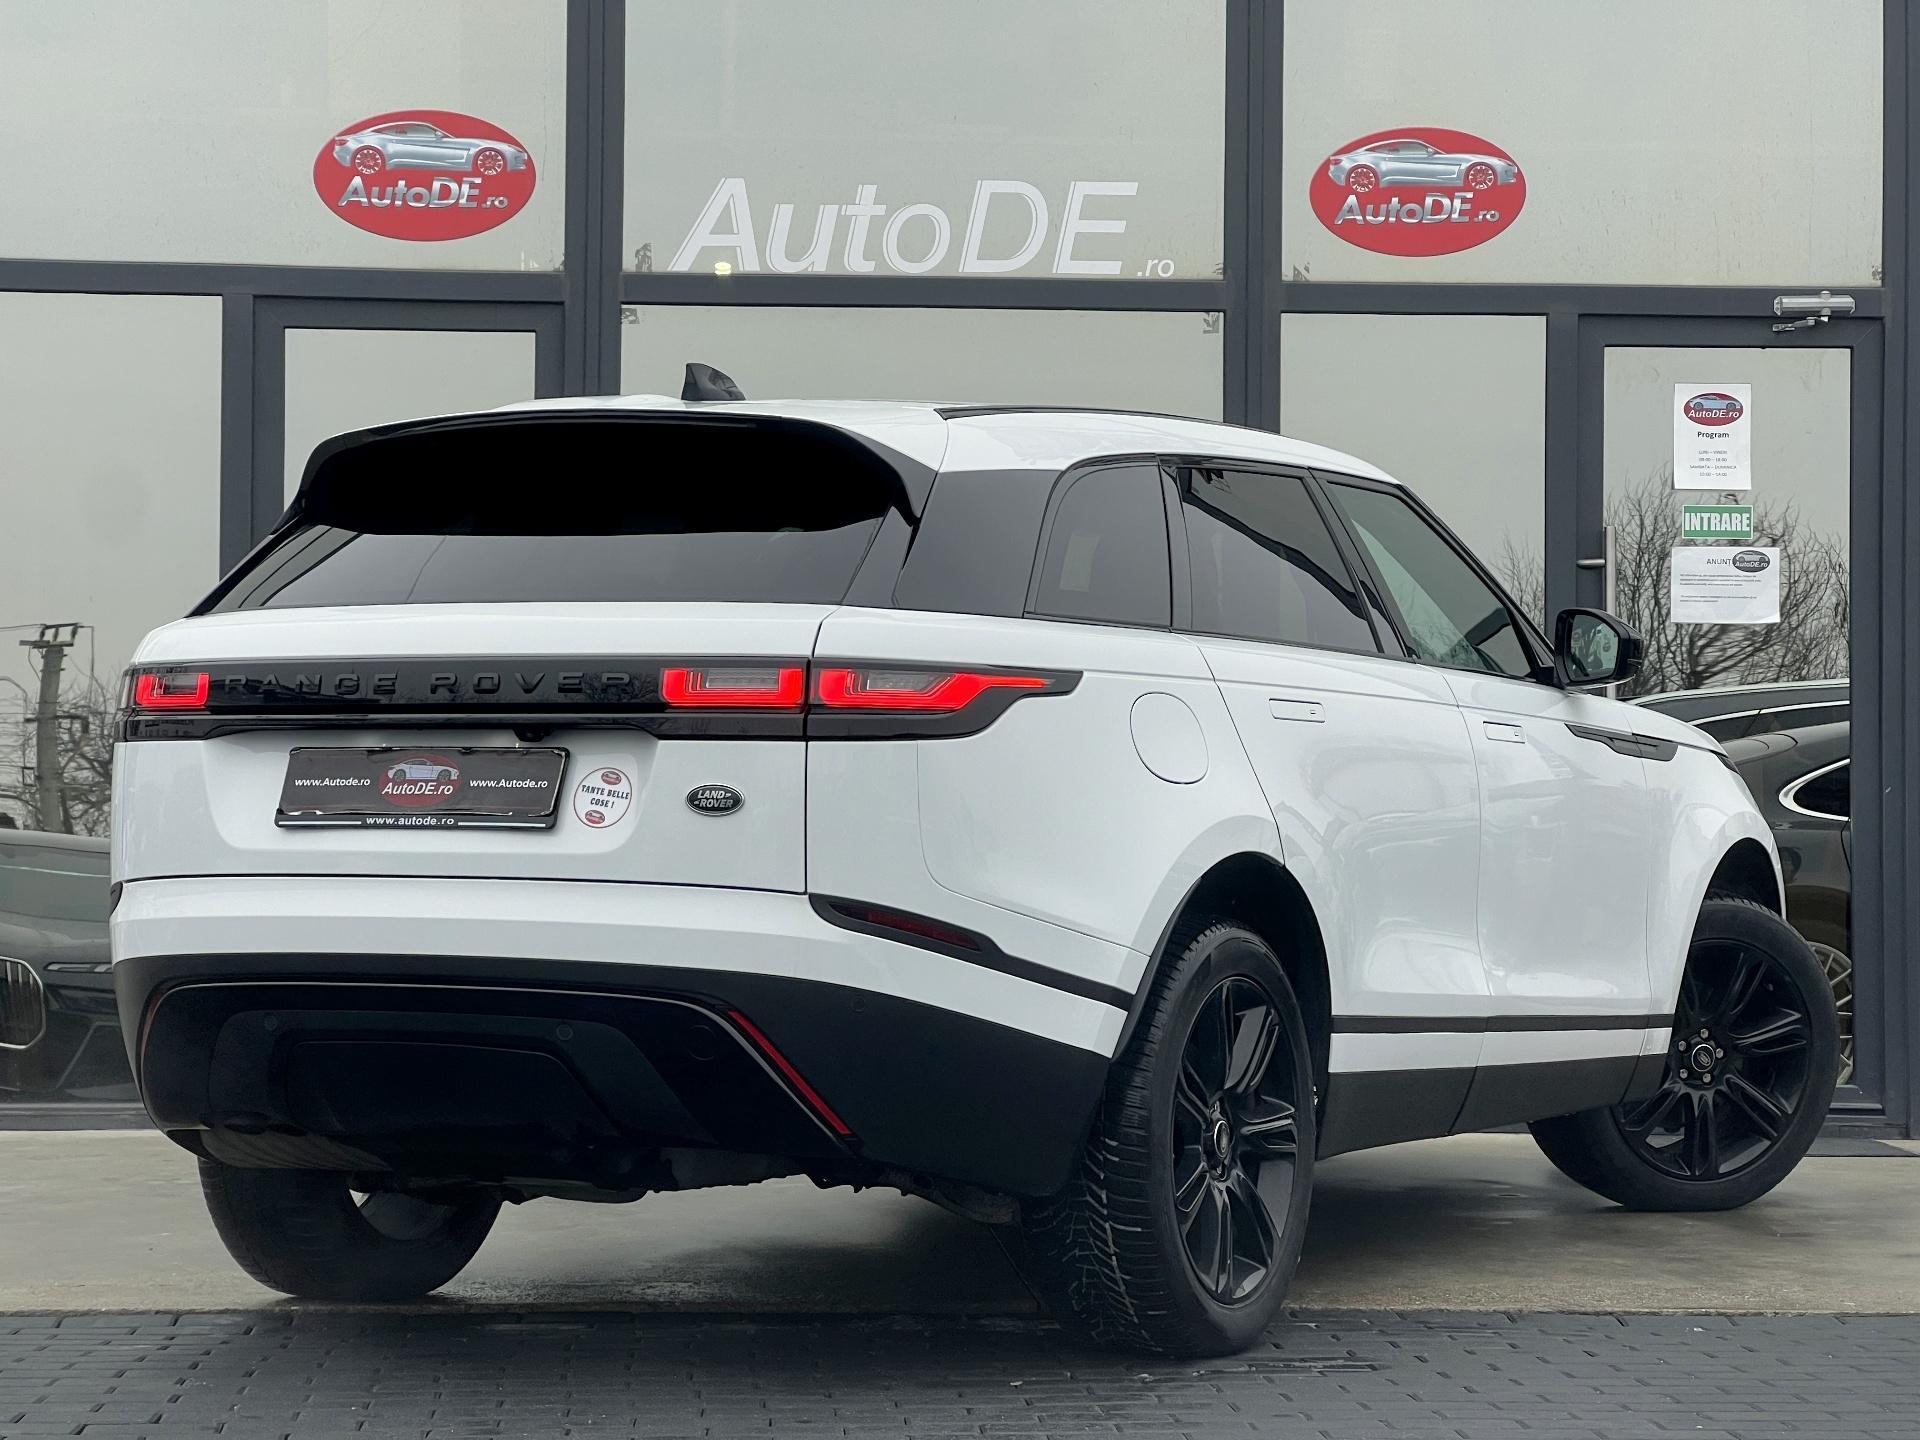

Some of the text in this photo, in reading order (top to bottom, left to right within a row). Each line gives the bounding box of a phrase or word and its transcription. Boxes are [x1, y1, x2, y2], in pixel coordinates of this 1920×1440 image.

[338, 175, 482, 208] AutoDE
[1334, 191, 1474, 225] AutoDE
[667, 177, 1175, 278] AutoDE .ro
[1688, 409, 1740, 418] AutoDE.ro
[1697, 431, 1730, 440] Program
[1684, 512, 1750, 531] INTRARE
[224, 671, 632, 696] RANGE ROVER
[294, 777, 371, 787] www.Autode.ro
[469, 778, 549, 789] www.Autode.ro
[381, 781, 454, 796] AutoDE.ro
[581, 784, 630, 800] TANTE BELLE
[697, 790, 725, 799] LAND
[590, 797, 610, 808] COSE
[699, 798, 734, 808] ROVER
[366, 816, 455, 826] www.autode.ro
